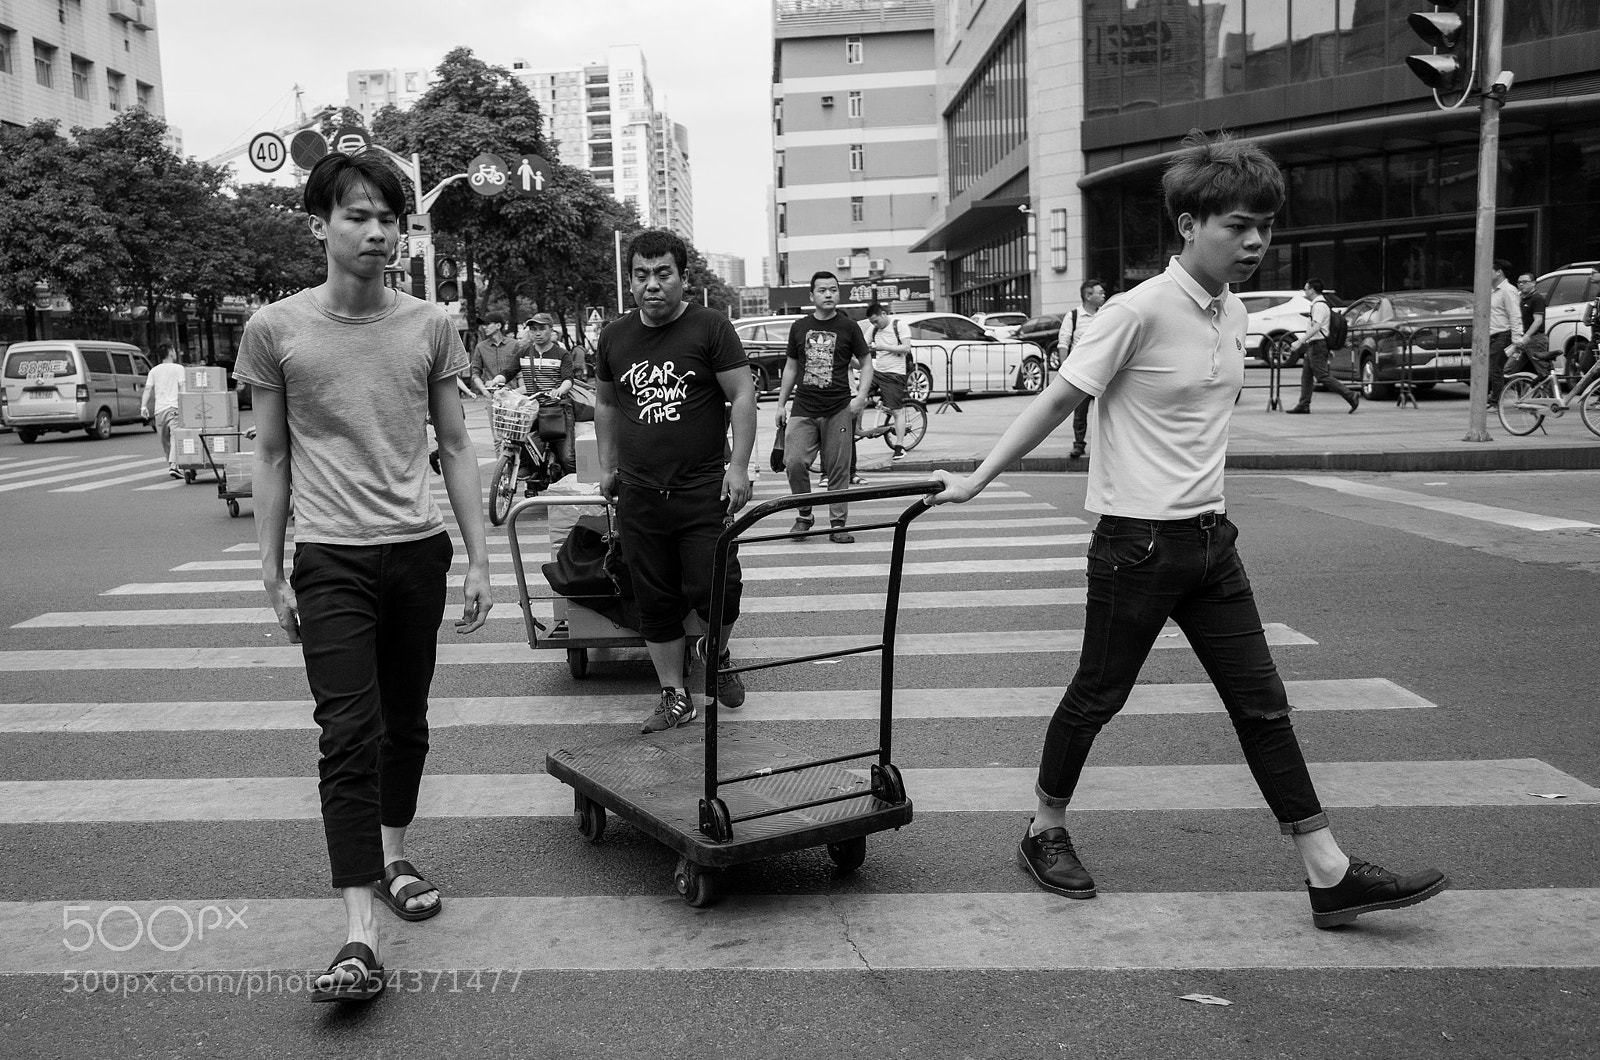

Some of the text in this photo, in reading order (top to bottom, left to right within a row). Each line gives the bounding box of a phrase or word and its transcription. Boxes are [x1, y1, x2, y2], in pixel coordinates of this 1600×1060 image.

[257, 142, 278, 162] 40
[620, 360, 696, 395] TEAR
[637, 383, 688, 406] DOWN
[638, 401, 682, 424] THE
